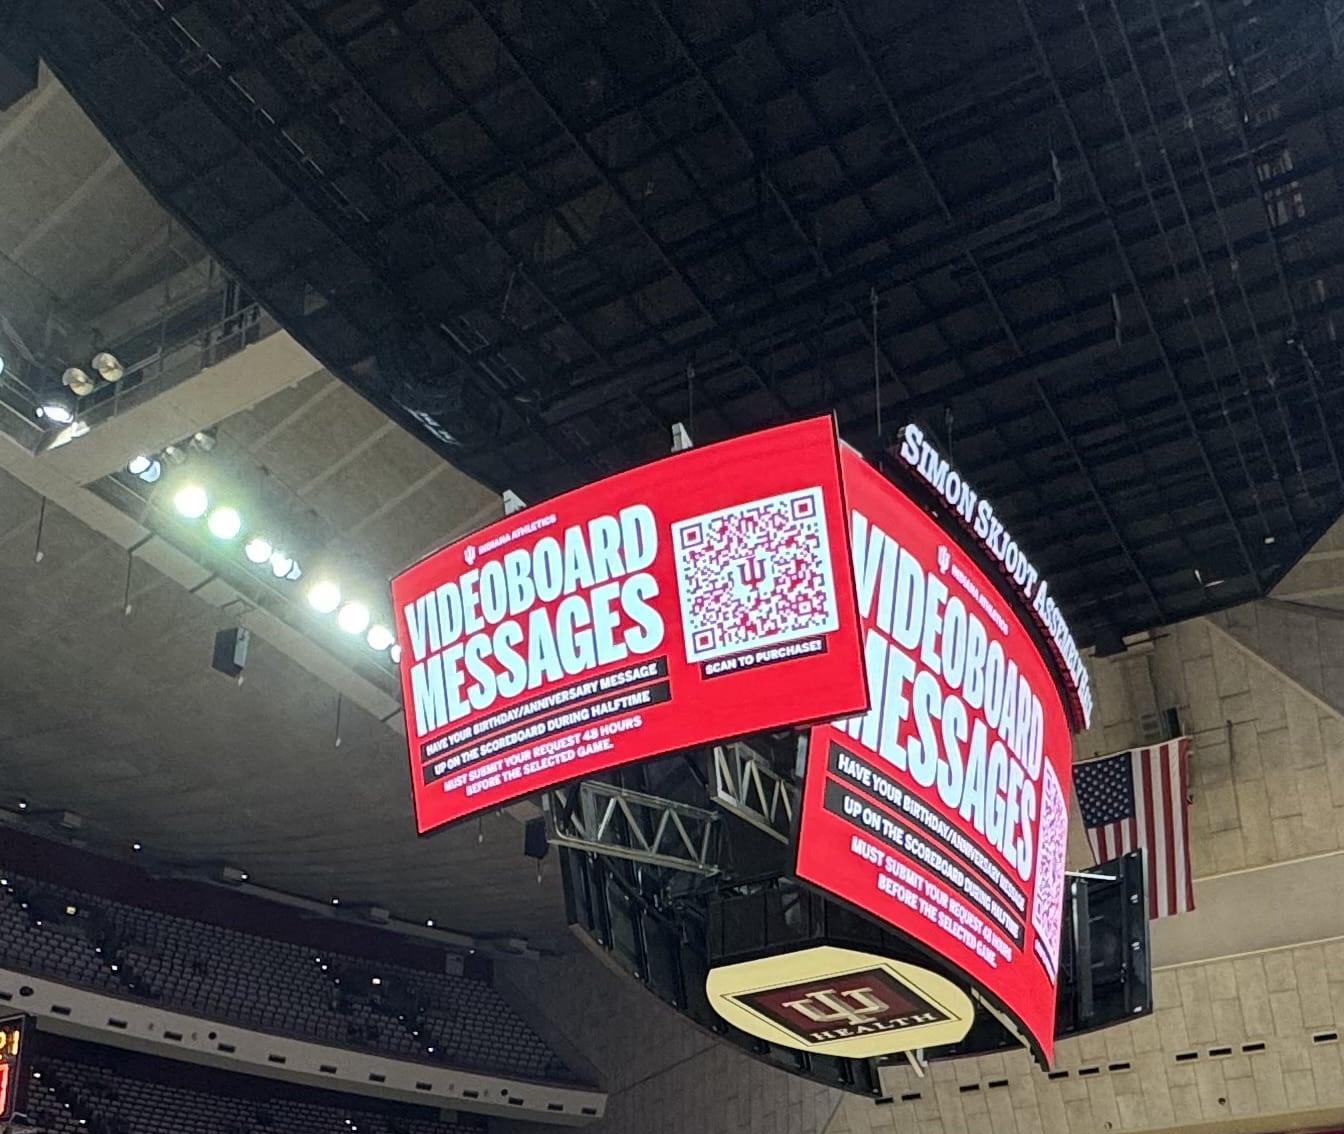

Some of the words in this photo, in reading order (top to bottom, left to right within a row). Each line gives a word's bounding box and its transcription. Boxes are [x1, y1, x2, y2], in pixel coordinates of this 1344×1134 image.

[478, 534, 511, 555] INDIANA
[510, 514, 557, 541] ATHLETICS
[901, 423, 978, 523] SIMON
[974, 500, 1038, 597] SKJODT
[404, 504, 658, 662] VIDEOBOARD
[410, 572, 665, 737] MESSAGES
[705, 662, 737, 675] SCAN
[737, 656, 756, 667] TO
[756, 640, 823, 663] PURCHASE!
[851, 509, 1044, 782] VIDEOBOARD
[426, 737, 448, 757] HAVE
[448, 728, 472, 749] YOUR
[472, 680, 599, 741] BIRTHDAY/ANNIVERSARY
[600, 662, 658, 690] MESSAGE
[434, 763, 447, 776] UP
[447, 757, 461, 772] ON
[461, 749, 480, 766] THE
[480, 723, 546, 760] SCOREBOARD
[547, 709, 590, 734] DURING
[591, 690, 651, 719] HALFTIME
[443, 774, 468, 792] MUST
[469, 761, 504, 784] SUBMIT
[504, 749, 533, 772] YOUR
[533, 733, 581, 761] REQUEST
[582, 728, 600, 742] 48
[600, 715, 643, 736] HOURS
[831, 627, 1037, 882] MESSAGES
[466, 775, 501, 797] BEFORE
[502, 768, 522, 785] THE
[523, 748, 576, 779] SELECTED
[577, 739, 614, 759] GAME.
[838, 753, 871, 786] HAVE
[871, 771, 903, 807] YOUR
[843, 796, 863, 817] UP
[862, 808, 881, 830] ON
[882, 816, 904, 845] THE
[904, 834, 965, 892] SCOREBOARD
[851, 835, 885, 866] MUST
[885, 857, 924, 891] SUBMIT
[923, 879, 948, 909] YOUR
[948, 893, 983, 934] REQUEST
[878, 873, 918, 909] BEFORE
[919, 902, 938, 923] THE
[937, 913, 977, 952] SELECTED
[809, 1012, 939, 1042] HEALTH
